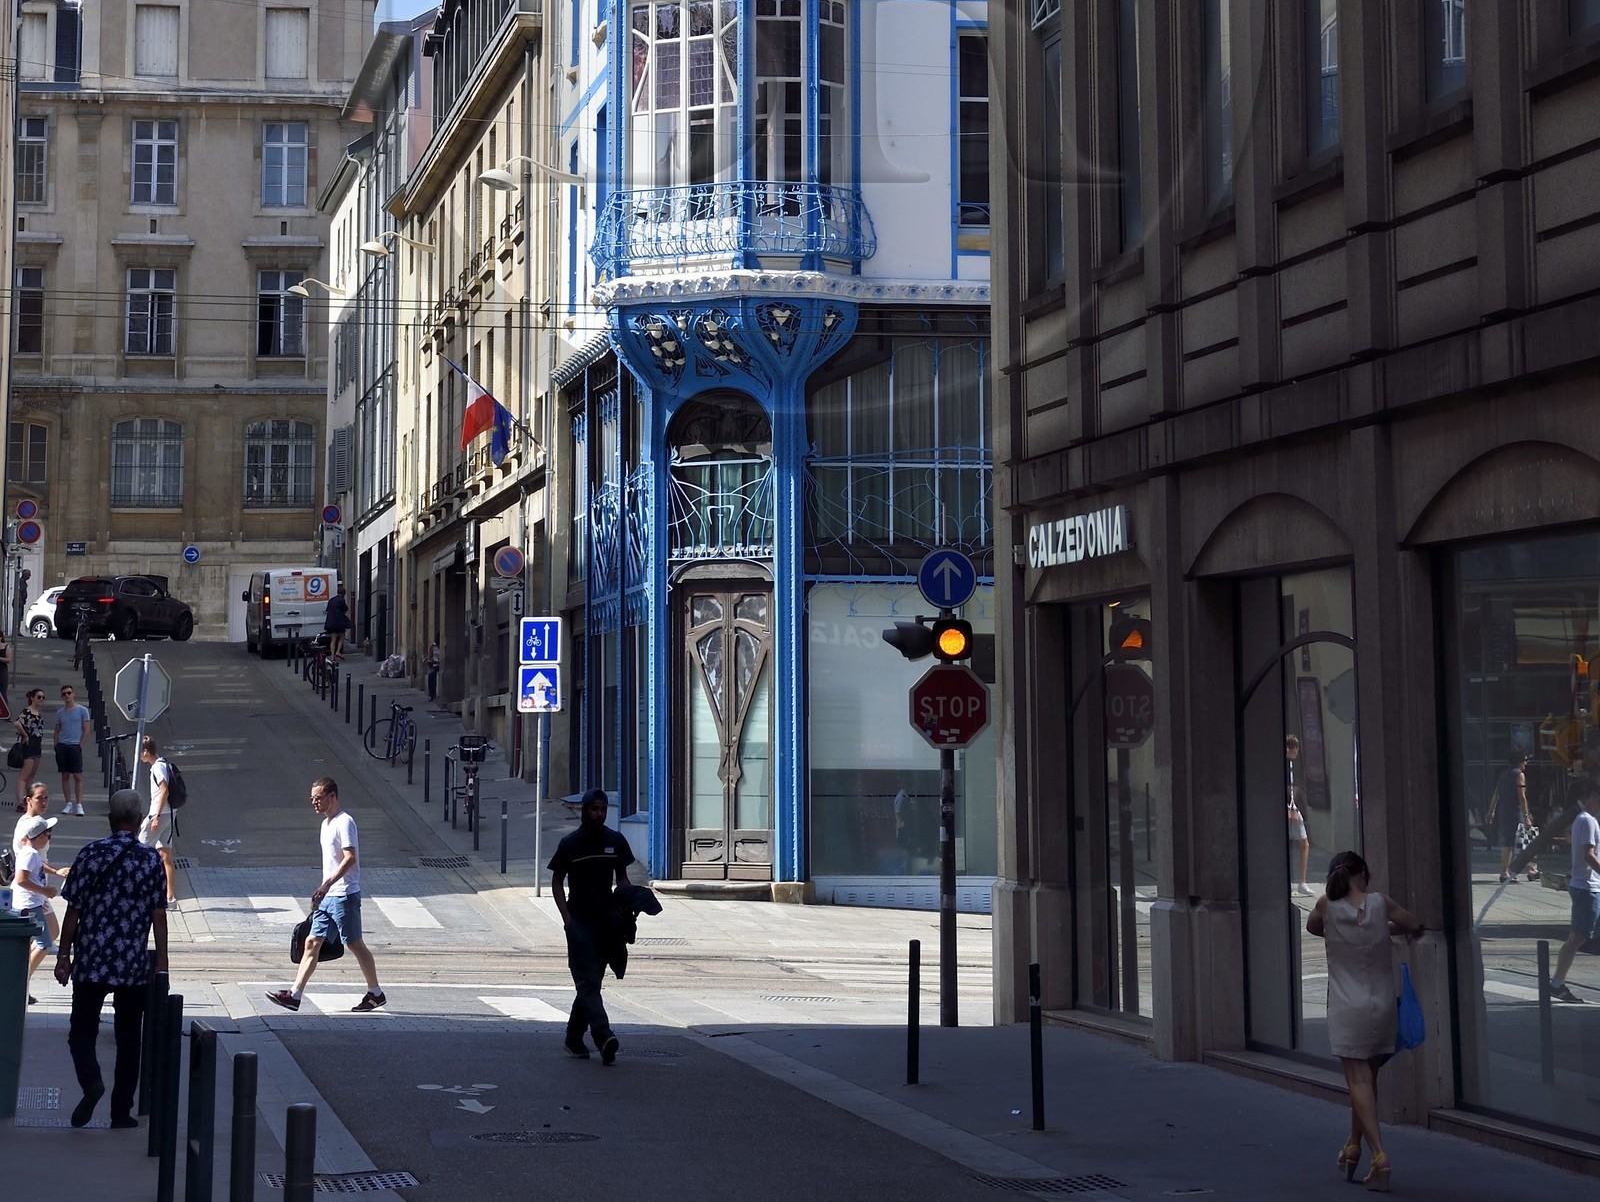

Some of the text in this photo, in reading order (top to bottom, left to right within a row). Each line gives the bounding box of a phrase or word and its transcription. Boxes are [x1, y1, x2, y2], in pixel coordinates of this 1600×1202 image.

[1028, 504, 1126, 569] CALZEDONIA
[310, 578, 321, 594] 9
[920, 695, 981, 718] STOP
